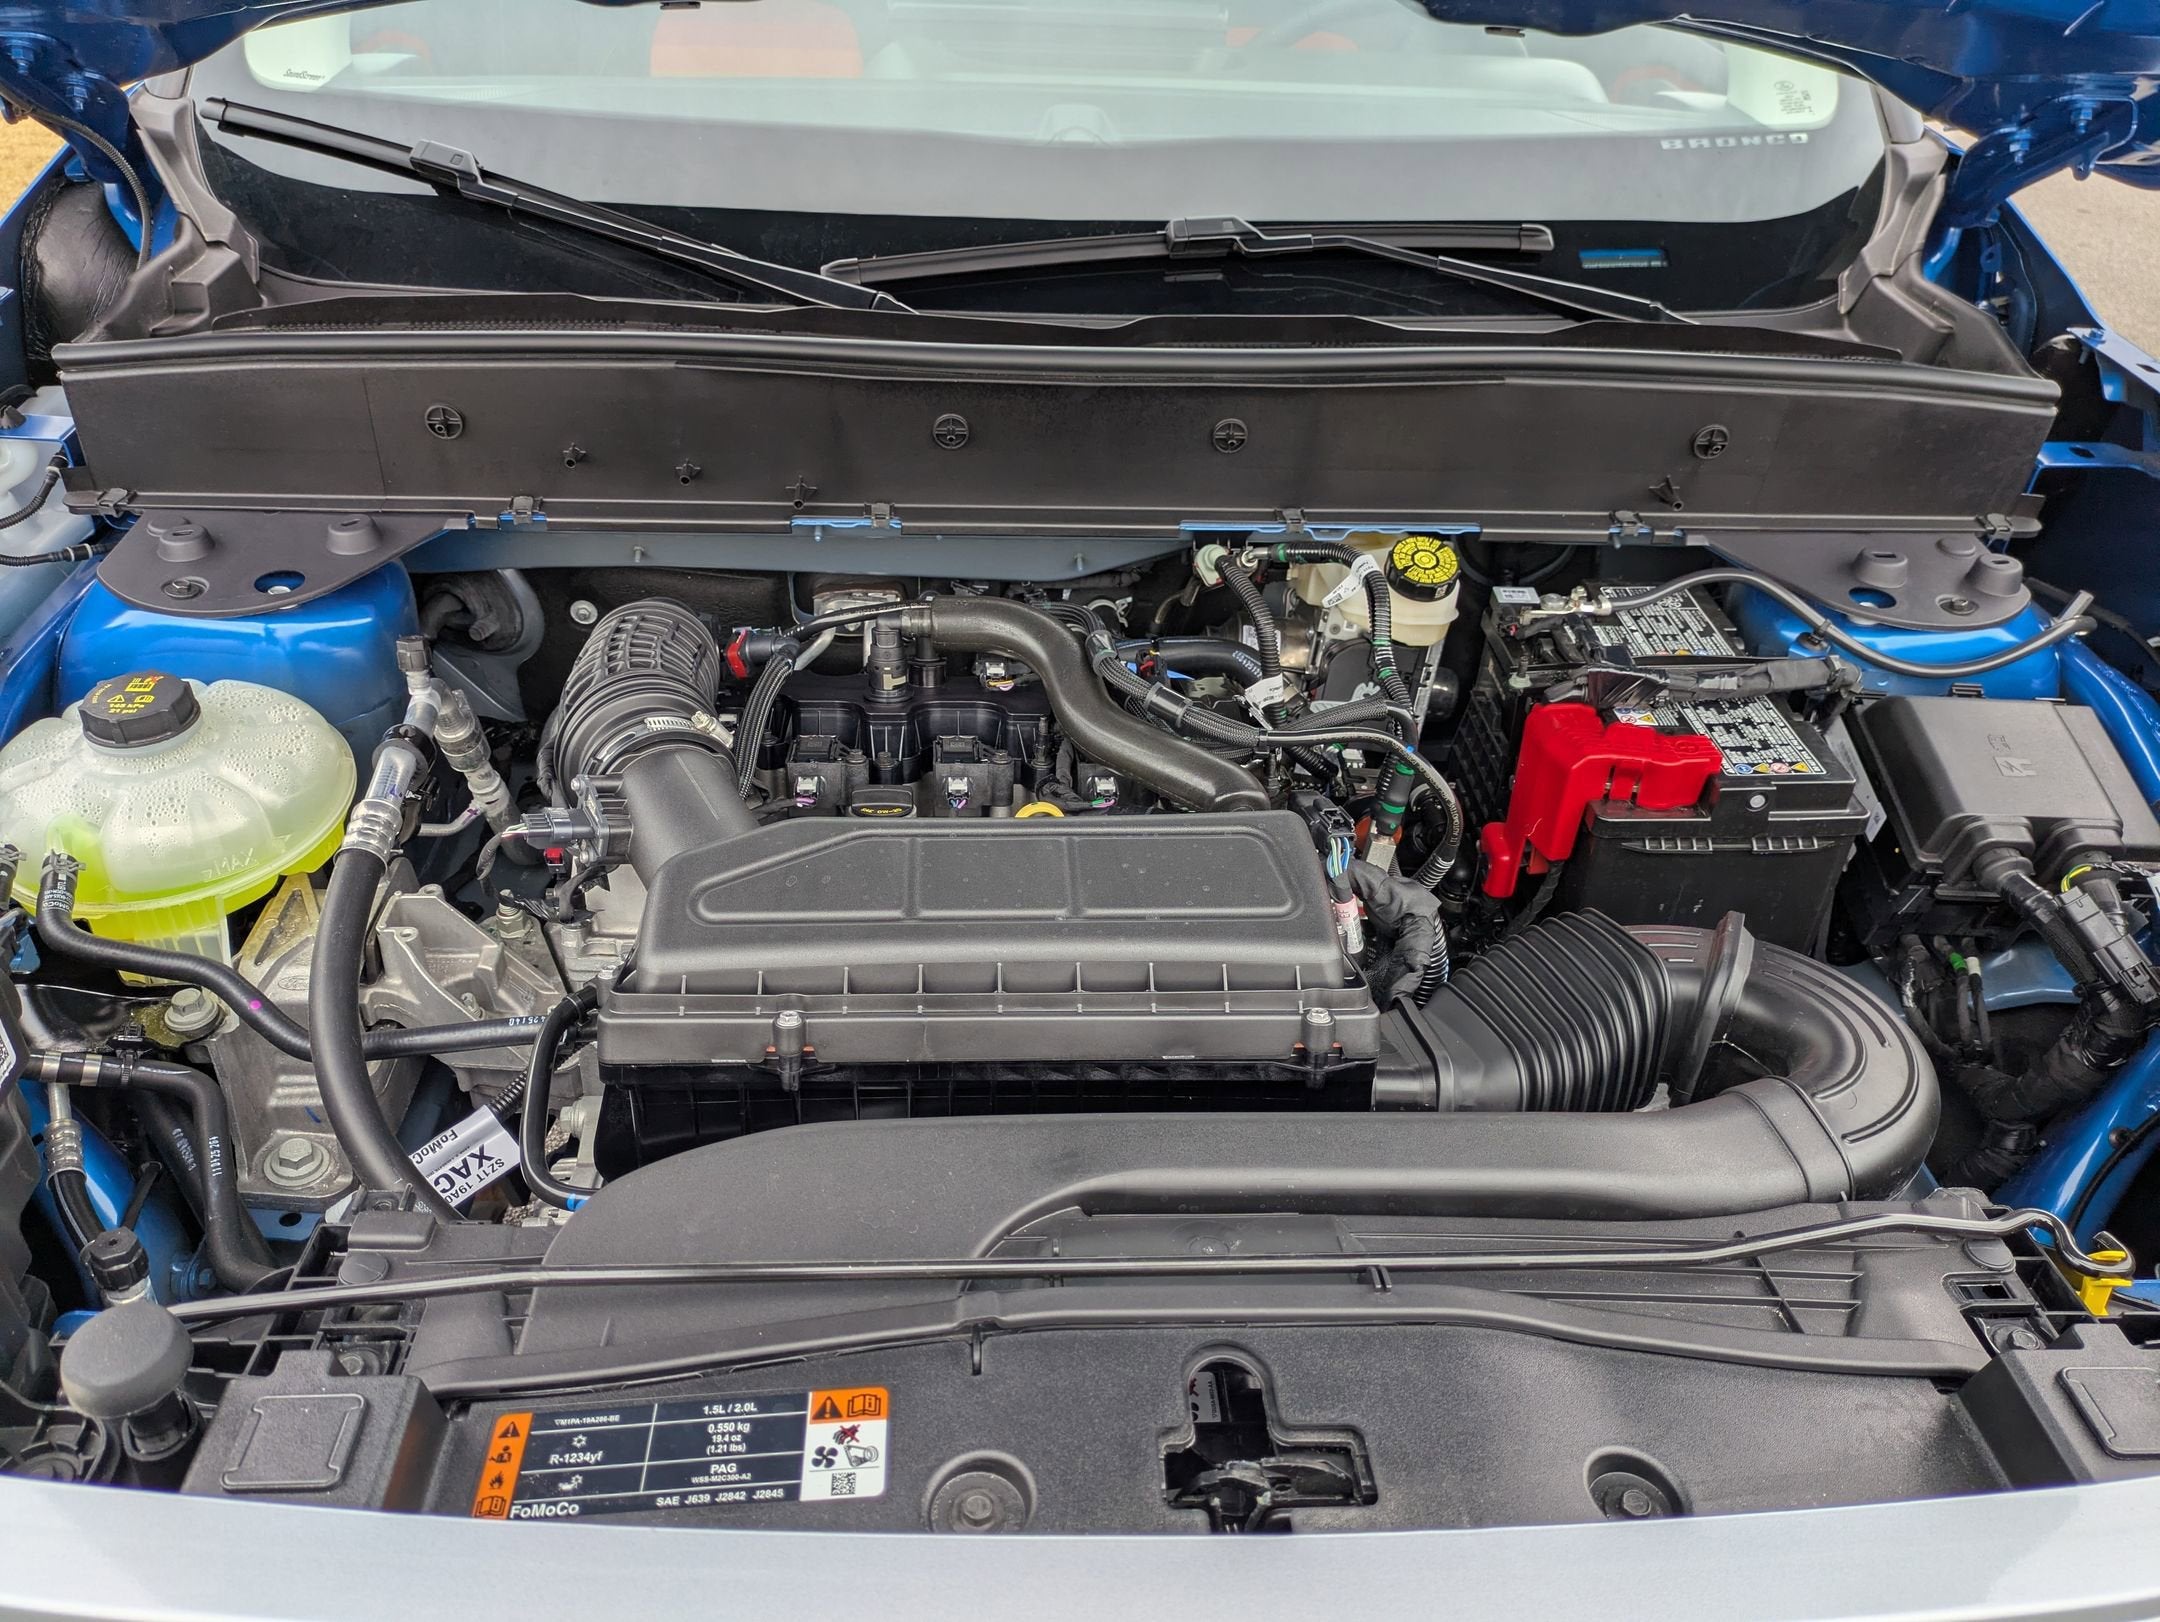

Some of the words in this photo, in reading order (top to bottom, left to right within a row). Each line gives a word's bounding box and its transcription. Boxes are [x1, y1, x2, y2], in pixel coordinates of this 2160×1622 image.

[1660, 132, 1809, 150] BRONCO
[412, 1129, 459, 1165] FoMoC
[433, 1143, 495, 1195] XAC
[703, 1404, 726, 1416] 1.5L
[734, 1402, 758, 1413] 2.0L
[707, 1421, 735, 1434] 0.550
[737, 1421, 751, 1433] kg
[712, 1434, 729, 1443] 19.4
[731, 1434, 742, 1442] oz
[706, 1444, 727, 1456] (1.21
[729, 1443, 747, 1453] lbs)
[549, 1450, 603, 1465] R-1234yf
[710, 1463, 737, 1474] PAG
[656, 1495, 680, 1507] SAE
[684, 1493, 711, 1505] J639
[715, 1491, 746, 1502] J2842
[752, 1488, 785, 1499] J2845
[510, 1502, 580, 1519] FoMoCo
